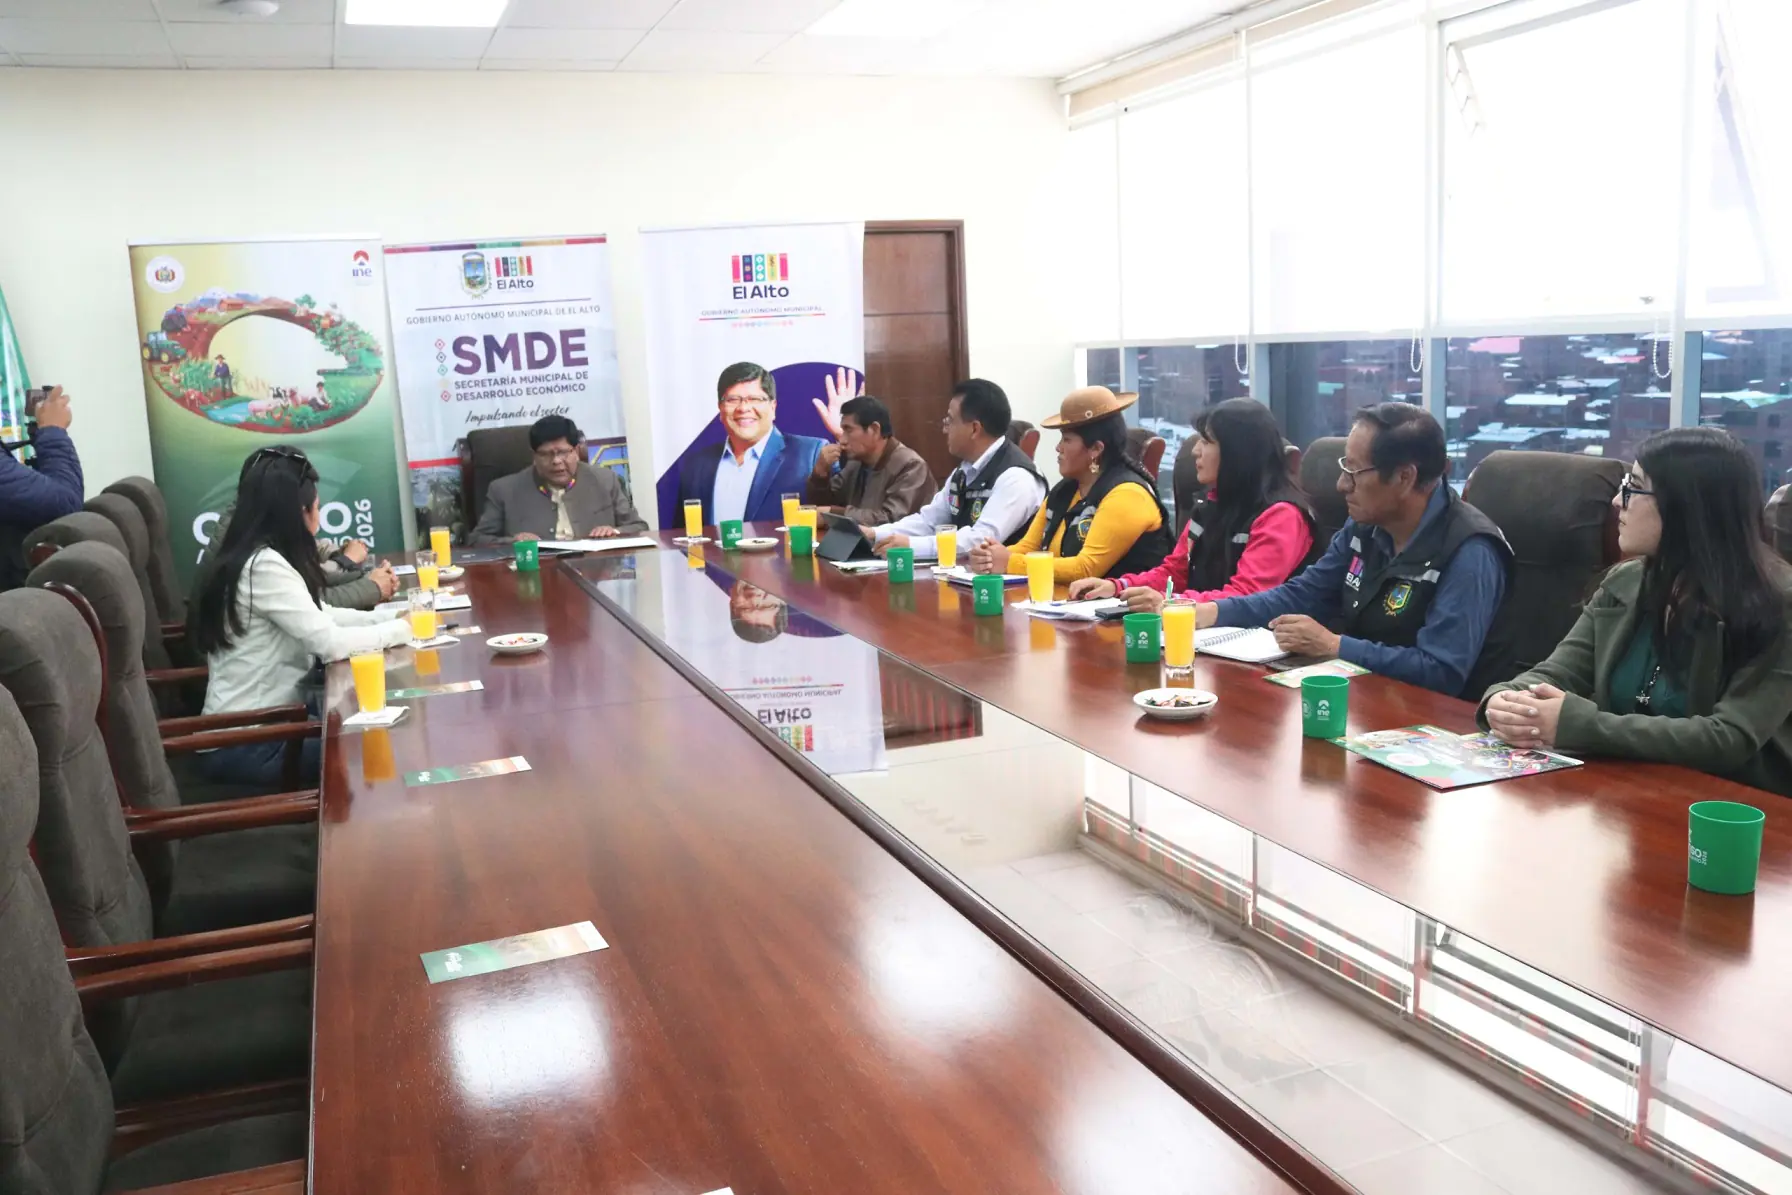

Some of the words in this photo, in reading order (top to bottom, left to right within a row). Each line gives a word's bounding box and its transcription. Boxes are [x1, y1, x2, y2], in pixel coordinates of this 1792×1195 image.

[497, 279, 507, 290] El
[508, 278, 534, 289] Alto
[733, 285, 747, 300] El
[750, 284, 790, 299] Alto
[406, 313, 452, 325] GOBIERNO
[454, 309, 505, 322] AUTÓNOMO
[507, 307, 552, 318] MUNICIPAL
[555, 306, 566, 316] DE
[568, 305, 577, 315] EL
[580, 304, 601, 314] ALTO
[452, 328, 589, 375] SMDE
[454, 375, 517, 390] SECRETARÍA
[519, 372, 573, 385] MUNICIPAL
[575, 370, 589, 381] DE
[455, 387, 523, 402] DESARROLLO
[526, 382, 586, 396] ECONÓMICO
[465, 405, 526, 426] Impulsando
[354, 498, 375, 549] 2026
